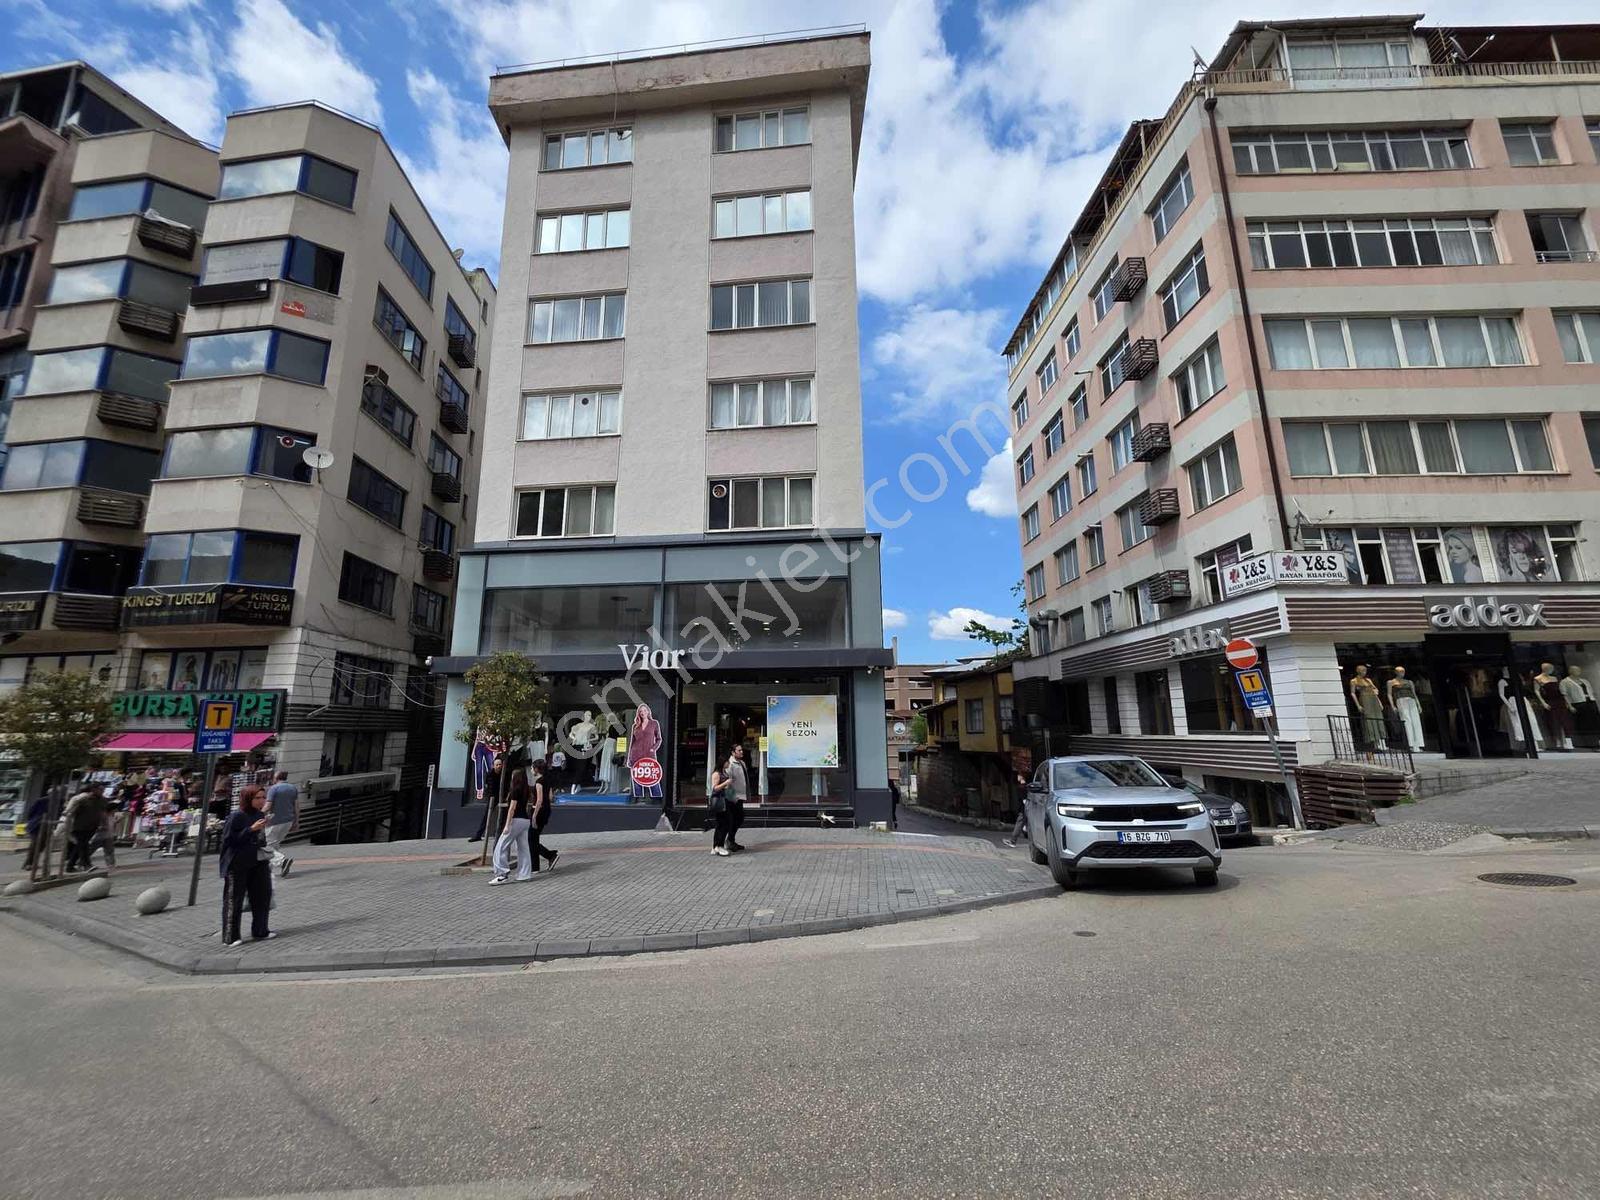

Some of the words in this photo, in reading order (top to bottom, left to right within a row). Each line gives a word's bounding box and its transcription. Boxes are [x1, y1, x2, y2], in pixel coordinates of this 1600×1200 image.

[1242, 559, 1267, 579] Y&S
[1302, 555, 1337, 571] Y&S
[1430, 596, 1551, 627] addax
[1169, 625, 1229, 656] addax
[617, 643, 686, 670] Viar
[1244, 674, 1256, 689] T
[112, 692, 195, 718] BURSA
[213, 706, 228, 726] T
[791, 720, 813, 728] YENİ
[786, 729, 818, 737] SEZON
[1123, 832, 1132, 841] 16
[1136, 832, 1151, 841] BZG
[1155, 831, 1170, 841] 710
